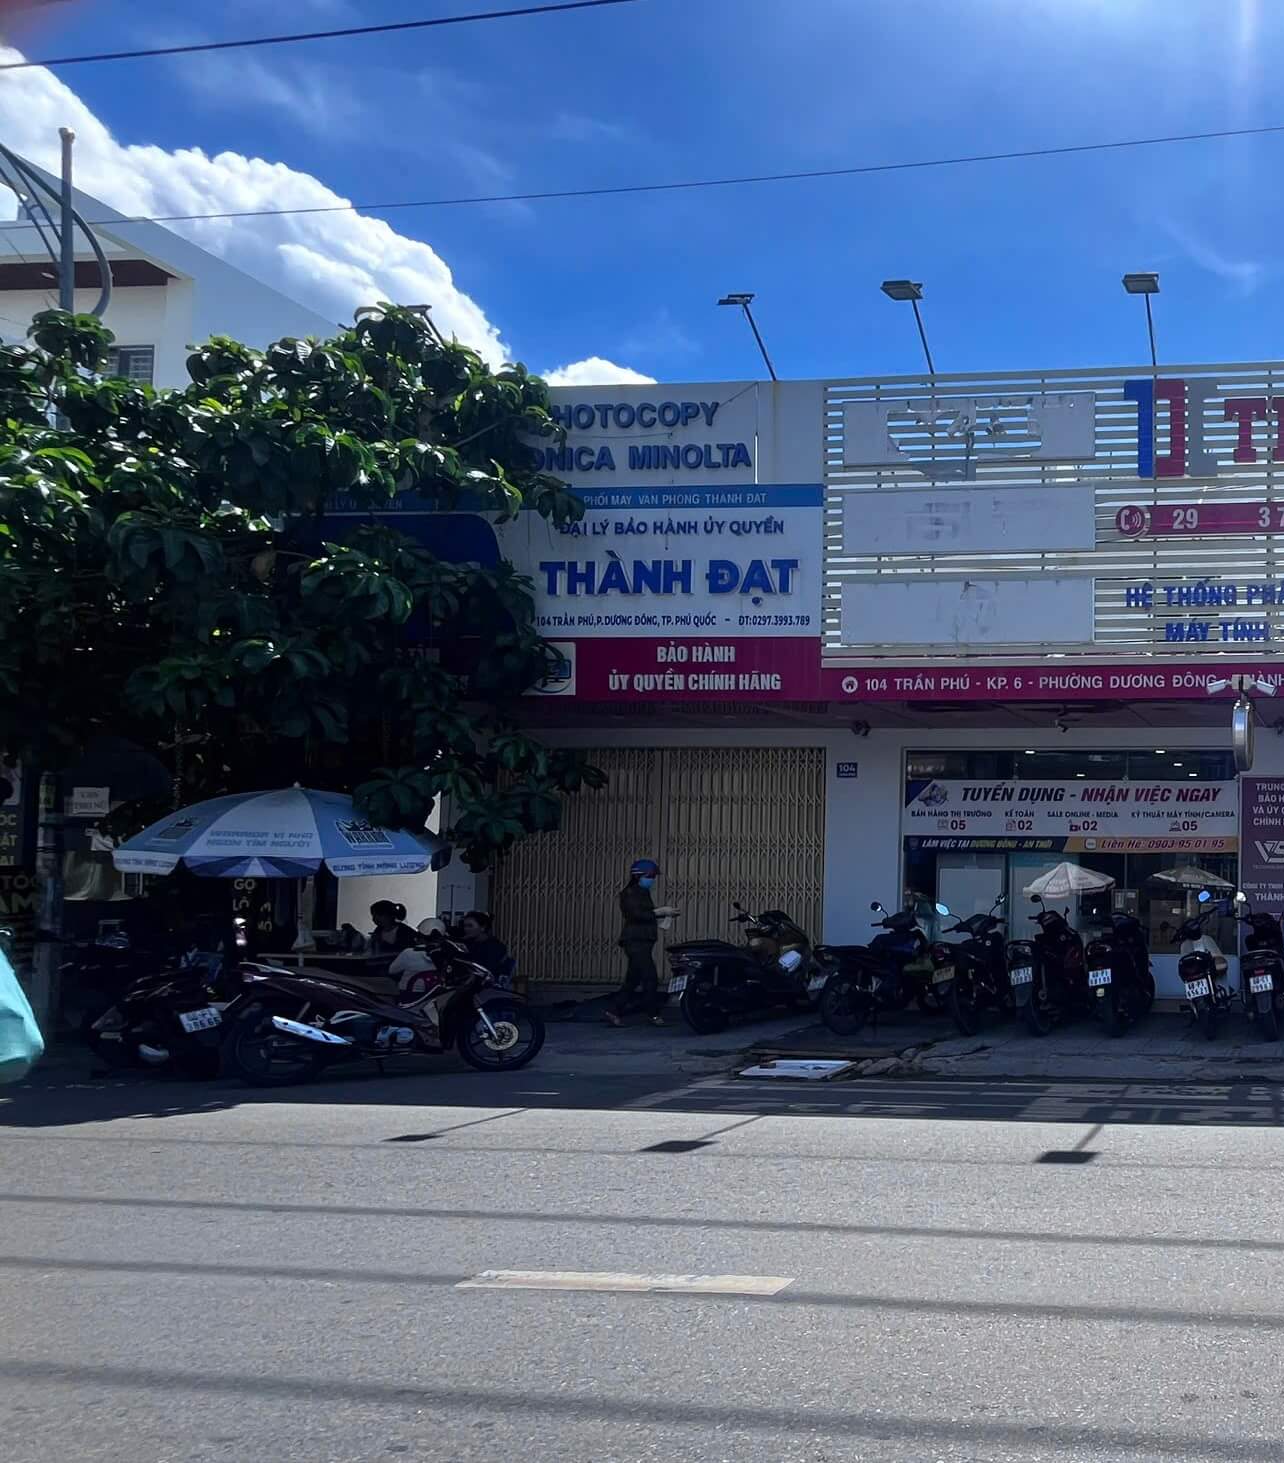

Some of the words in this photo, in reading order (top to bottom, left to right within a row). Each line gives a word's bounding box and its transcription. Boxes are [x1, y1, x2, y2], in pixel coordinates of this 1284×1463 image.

[546, 402, 719, 430] HOTOCOPY
[629, 443, 752, 470] MINOLTA
[592, 518, 609, 535] LÝ
[614, 516, 648, 535] BẢO
[653, 518, 698, 534] HÀNH
[703, 515, 725, 534] ỦY
[539, 550, 692, 595] THÀNH
[705, 559, 798, 606] ĐẠT
[1125, 582, 1152, 610] HỆ
[1166, 577, 1237, 607] THỐNG
[1165, 618, 1209, 641] MÁY
[1219, 617, 1270, 640] TÍNH
[656, 641, 688, 662] BẢO
[692, 642, 736, 662] HÀNH
[609, 669, 630, 690] ỦY
[634, 668, 684, 692] QUYỀN
[688, 670, 735, 690] CHÍNH
[739, 670, 782, 690] HÃNG
[866, 679, 887, 690] 104
[940, 674, 970, 690] PHÚ
[987, 678, 1008, 690] KP.
[1014, 677, 1022, 689] 6
[1039, 672, 1103, 689] PHƯỜNG
[1110, 674, 1166, 688] DƯƠNG
[962, 782, 1014, 801] TUYỂN
[1018, 787, 1065, 804] DỤNG
[1081, 785, 1130, 805] NHẬN
[1134, 785, 1172, 805] VIỆC
[1175, 787, 1221, 802] NGAY
[950, 819, 966, 831] 05
[1017, 819, 1033, 831] 02
[1082, 820, 1098, 831] 02
[1182, 820, 1198, 832] 05
